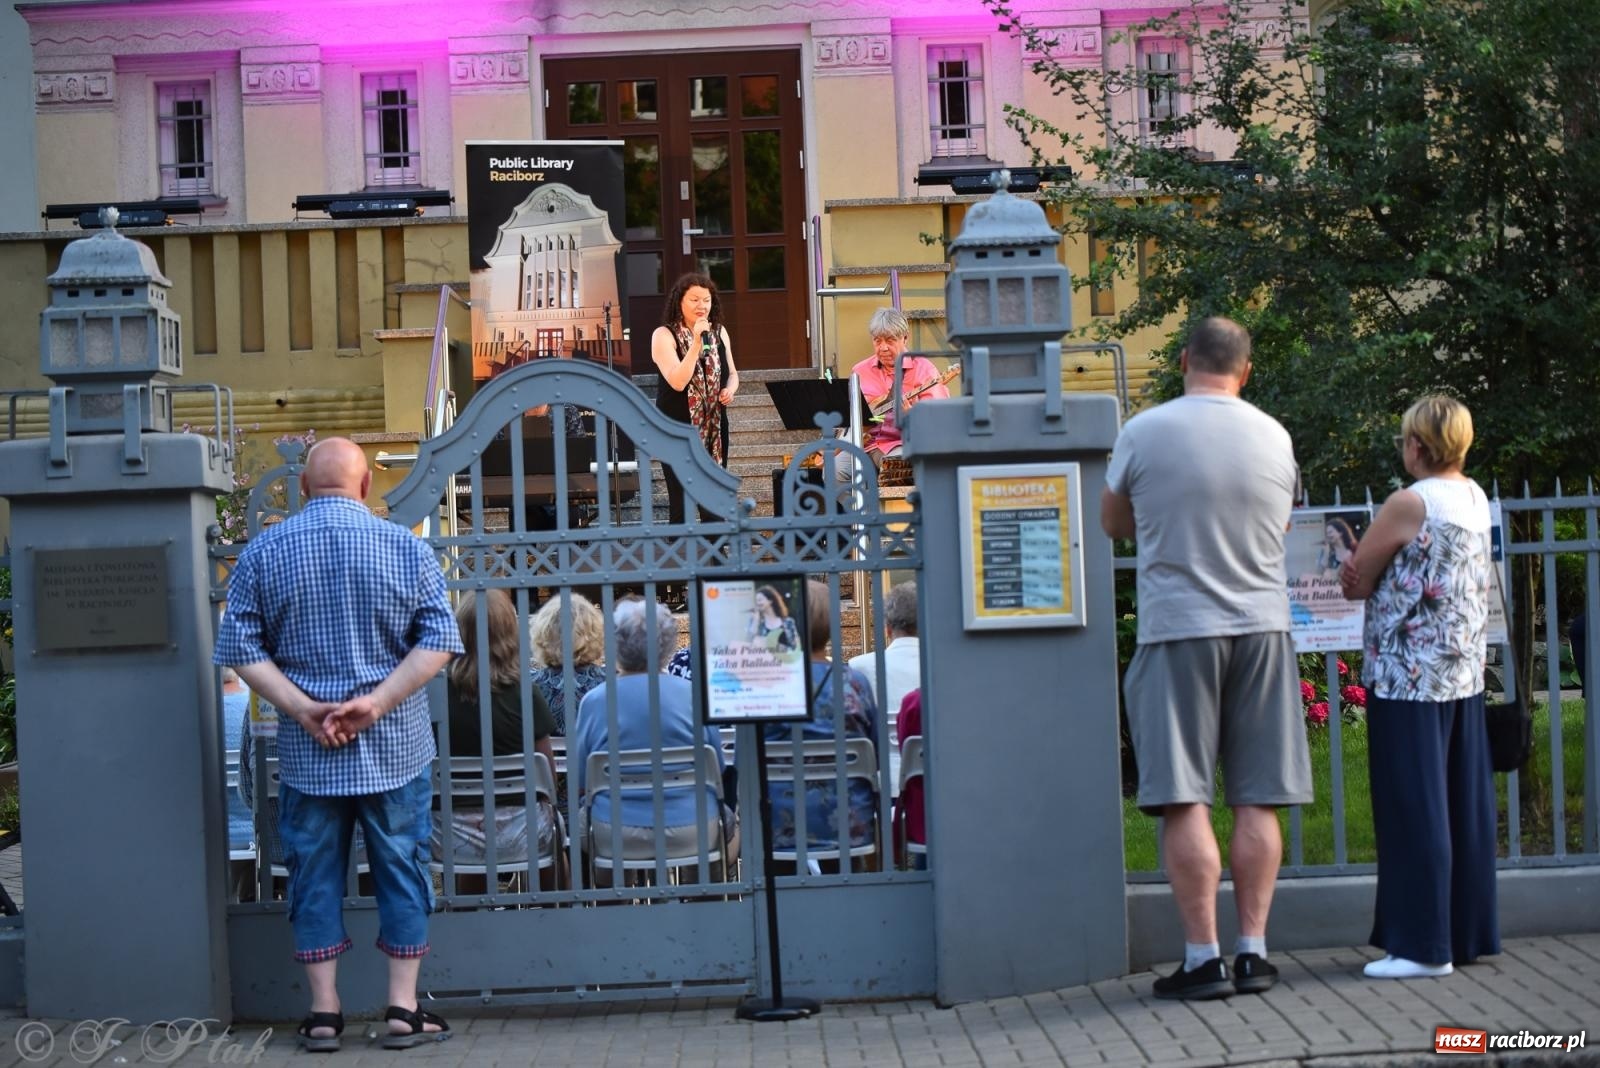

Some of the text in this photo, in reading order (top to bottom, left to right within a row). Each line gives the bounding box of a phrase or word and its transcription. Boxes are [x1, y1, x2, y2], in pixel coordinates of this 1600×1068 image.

[489, 157, 574, 171] Public Library
[489, 170, 545, 181] Raciborz
[455, 485, 472, 494] MAHA
[982, 483, 1056, 496] BIBLIOTEKA
[741, 658, 783, 668] Ballada
